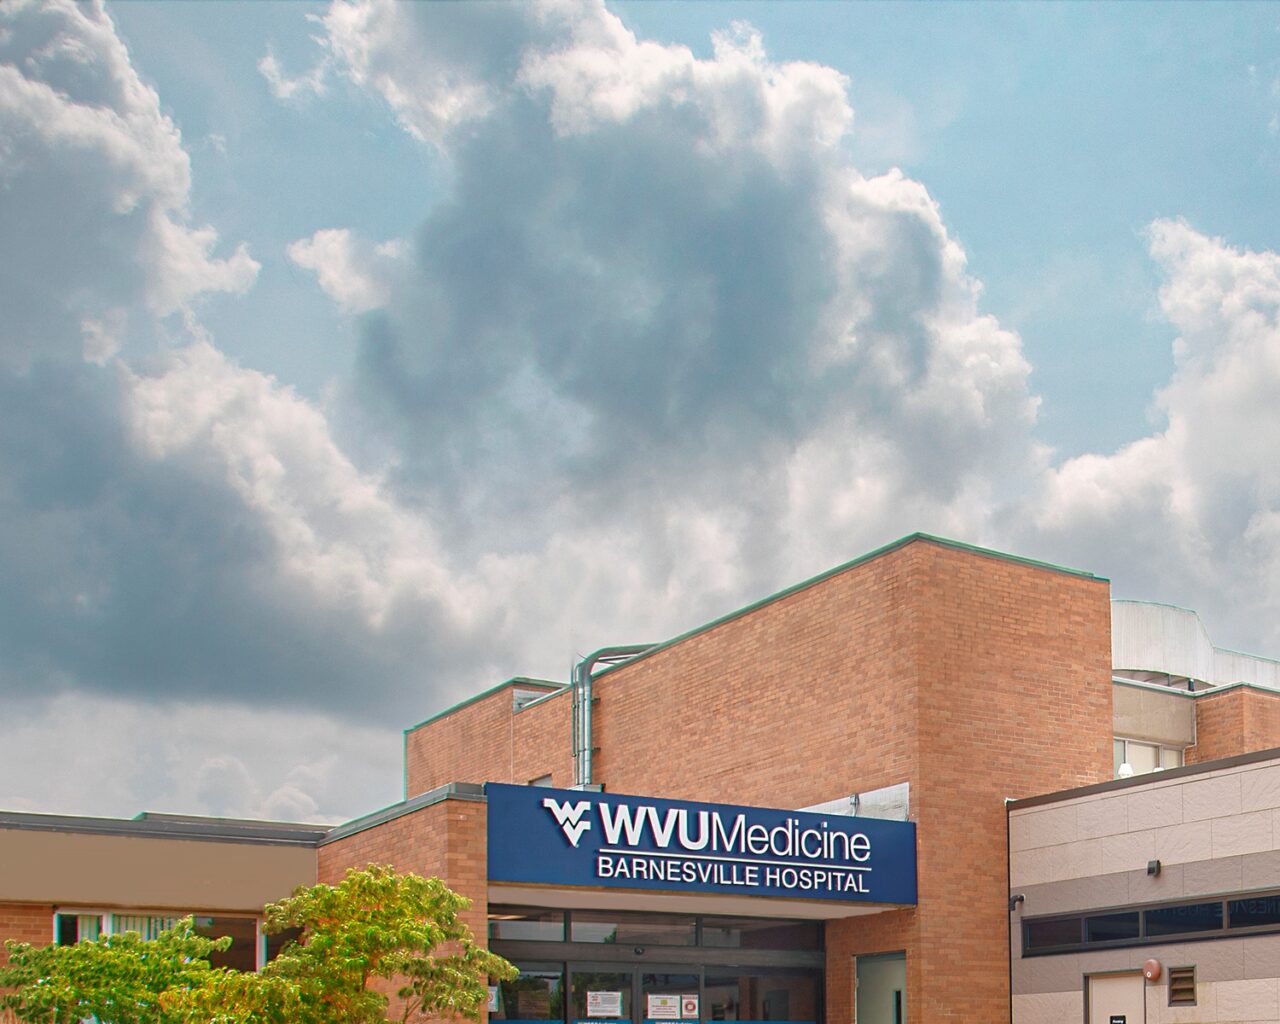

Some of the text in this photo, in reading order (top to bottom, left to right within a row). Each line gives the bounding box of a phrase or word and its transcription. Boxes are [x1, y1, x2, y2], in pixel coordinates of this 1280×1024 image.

[599, 802, 871, 862] WVUMedicine
[598, 856, 870, 893] BARNESVILLE HOSPITAL
